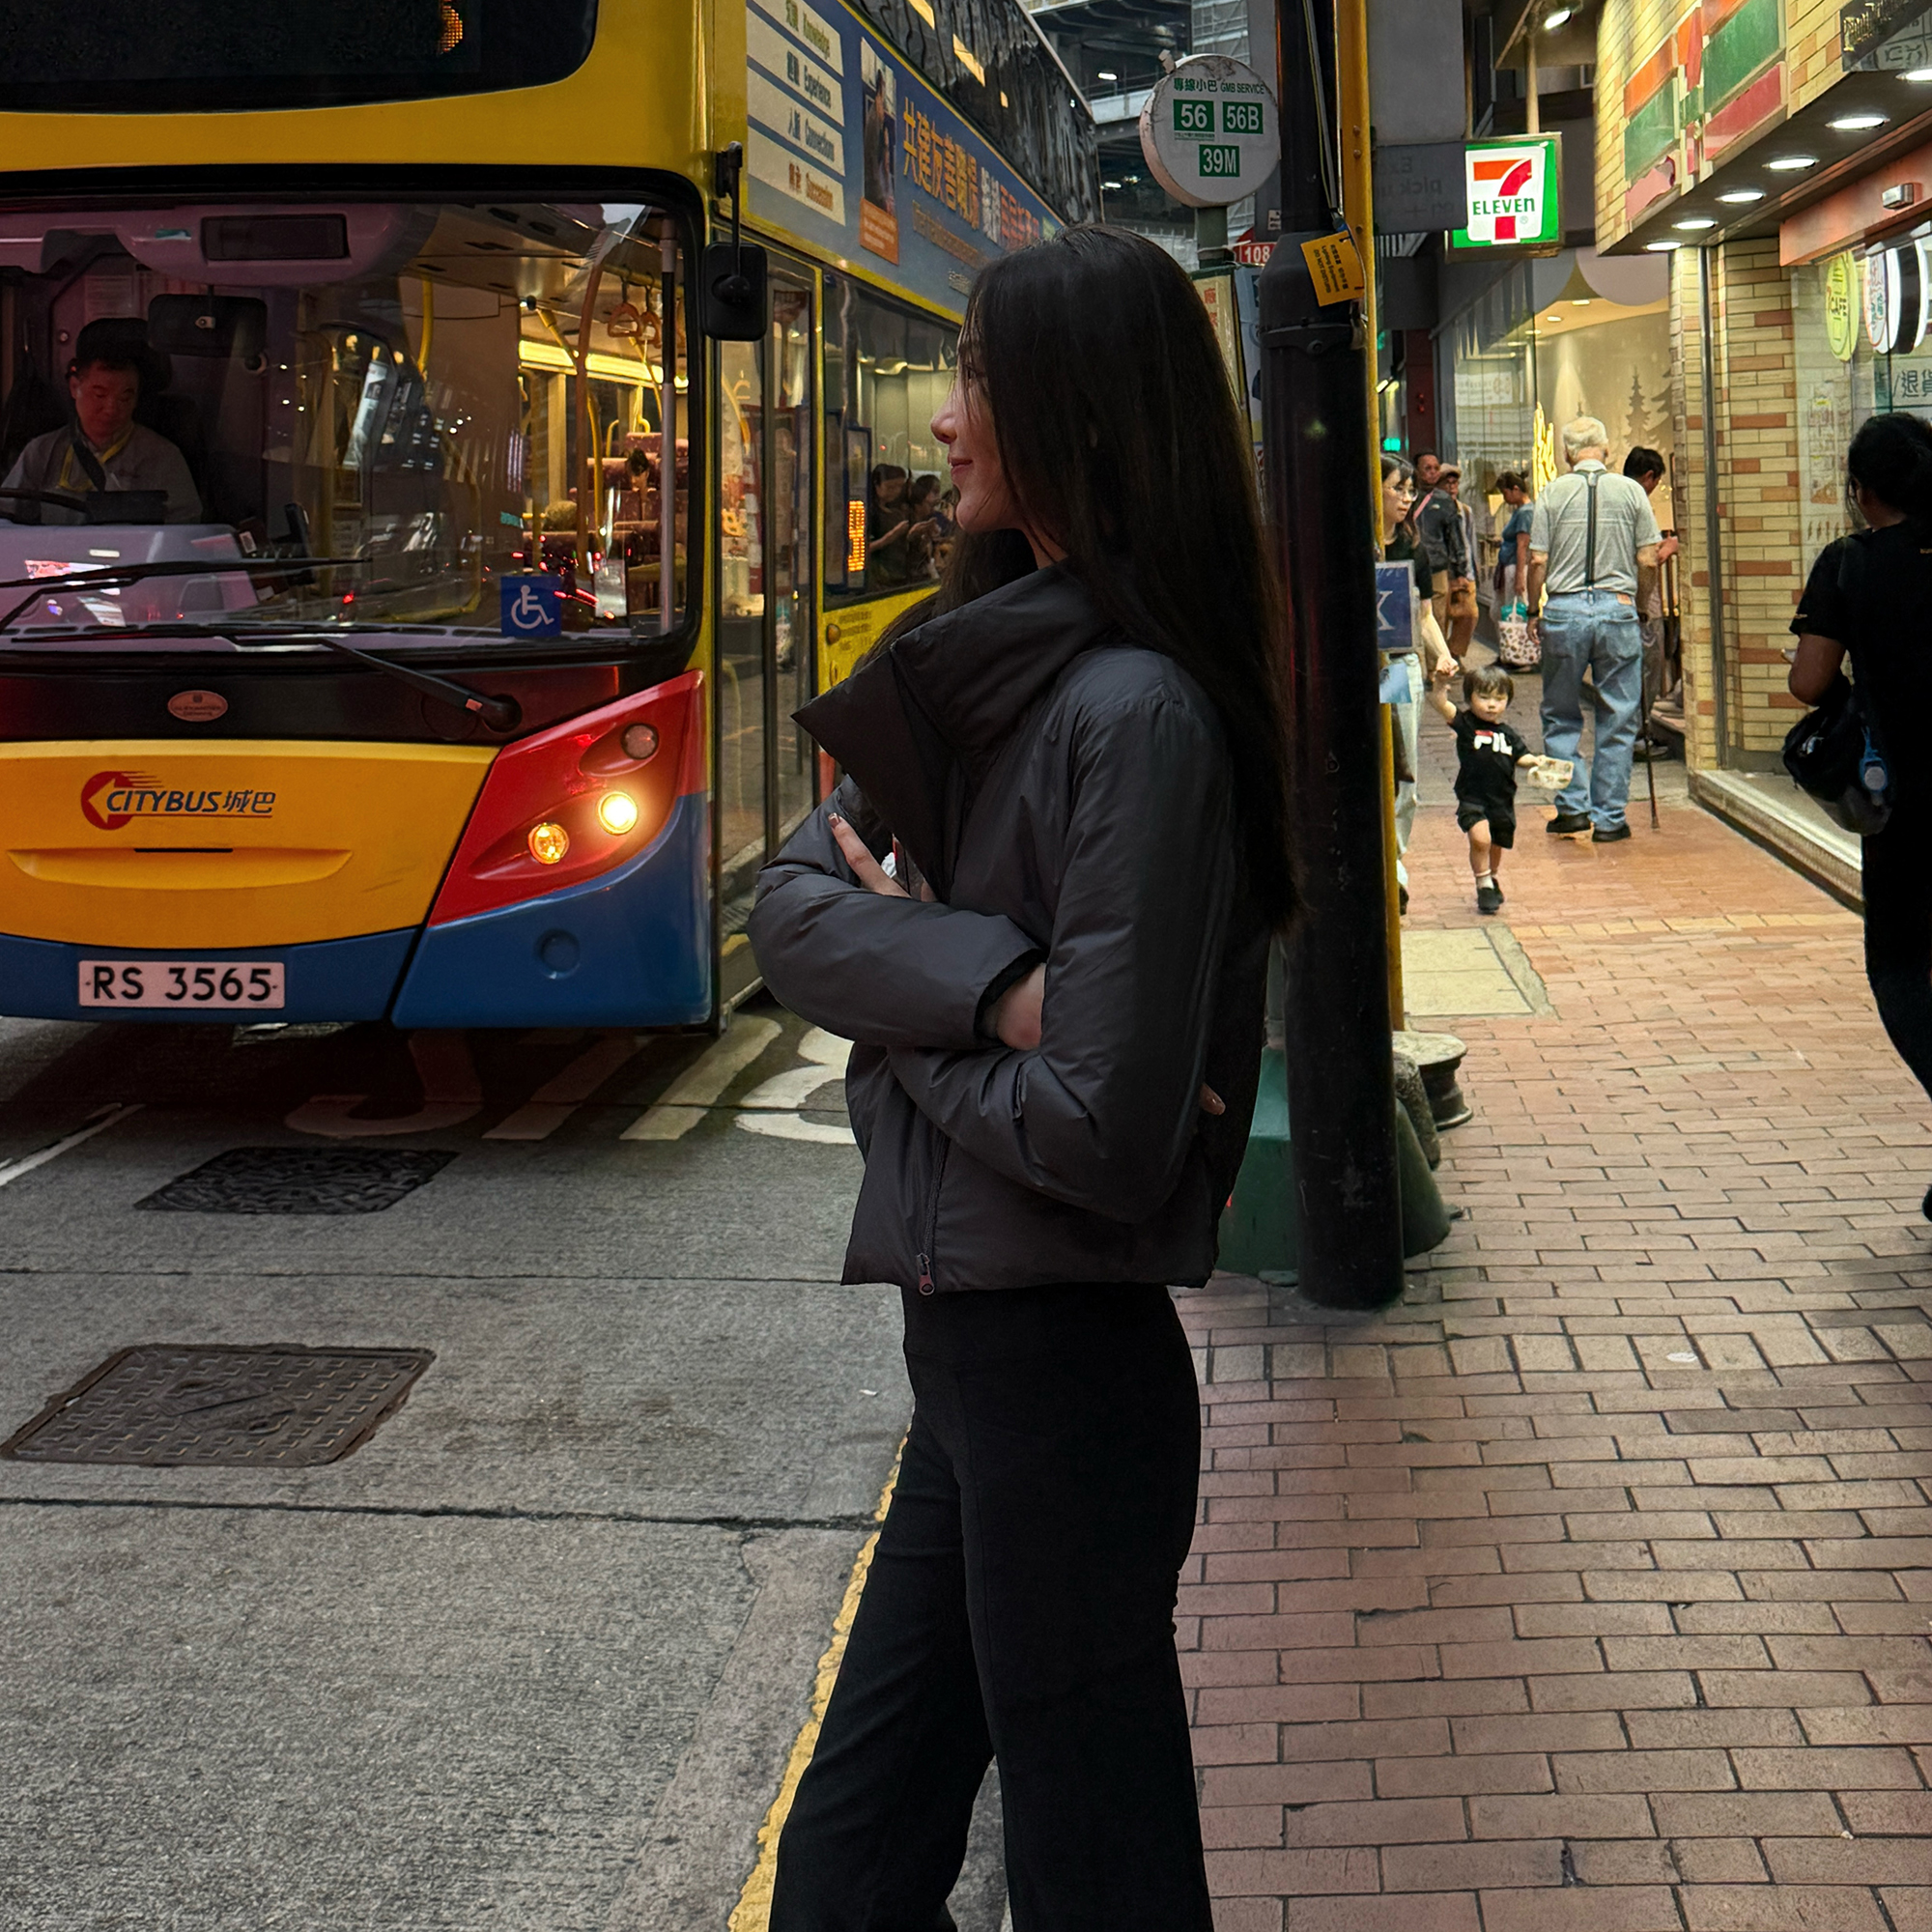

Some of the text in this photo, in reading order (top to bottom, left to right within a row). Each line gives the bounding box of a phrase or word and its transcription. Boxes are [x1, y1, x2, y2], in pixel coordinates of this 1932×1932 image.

[1173, 77, 1264, 95] 專線小巴 GMB SERVICE
[1180, 103, 1260, 130] 56 56B
[1203, 147, 1237, 174] 39M
[1473, 729, 1513, 756] FIL
[105, 789, 276, 813] CITYBUS 城巴
[92, 966, 272, 1002] RS 3565
